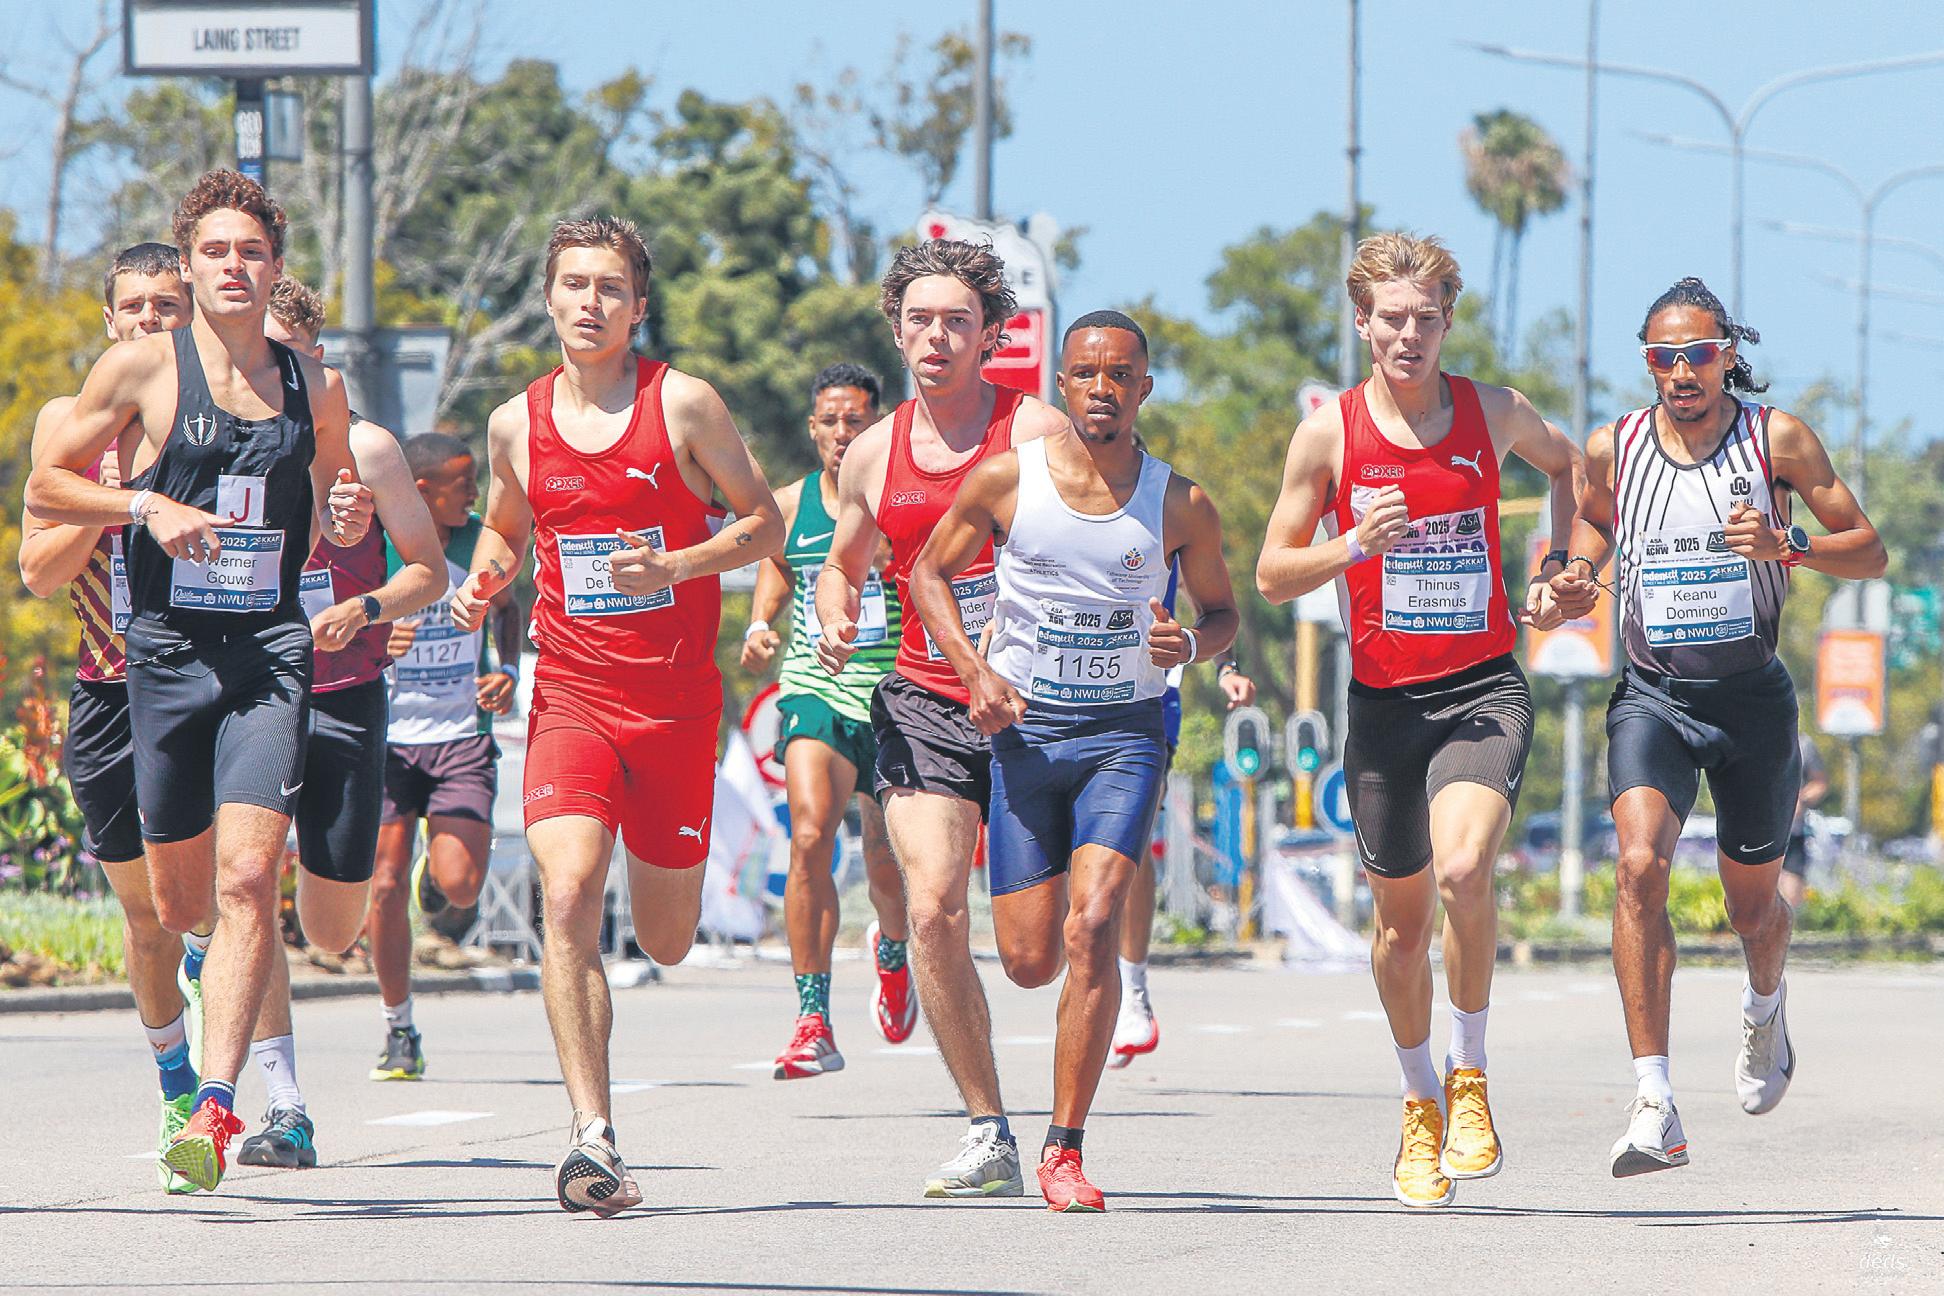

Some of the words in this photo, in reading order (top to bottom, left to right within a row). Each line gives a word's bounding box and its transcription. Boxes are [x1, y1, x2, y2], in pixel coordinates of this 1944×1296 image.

[194, 27, 240, 51] LAING
[245, 26, 301, 50] STREET
[229, 488, 251, 522] J
[1460, 514, 1479, 526] ASA
[1425, 520, 1450, 536] 2025
[220, 536, 247, 548] 2025
[1709, 533, 1725, 545] AS
[596, 541, 622, 551] 2025
[1674, 538, 1700, 553] 2025
[207, 552, 257, 568] Werner
[592, 559, 609, 572] Co
[1426, 560, 1452, 571] 2025
[206, 570, 254, 586] Gouws
[1680, 570, 1707, 581] 2025
[585, 577, 604, 589] De
[1416, 579, 1460, 591] Thinus
[954, 587, 971, 597] 025
[1673, 590, 1717, 602] Keanu
[217, 594, 245, 605] NWU
[606, 599, 632, 608] NWU
[1408, 595, 1467, 608] Erasmus
[960, 601, 986, 615] nder
[1666, 606, 1728, 620] Domingo
[963, 616, 993, 631] ens
[1074, 612, 1101, 628] 2025
[1426, 617, 1452, 627] NWU
[1687, 627, 1714, 638] NWU
[1077, 636, 1104, 647] 2025
[412, 641, 462, 664] 1127
[1054, 654, 1121, 679] 1155
[1074, 688, 1100, 699] NWU
